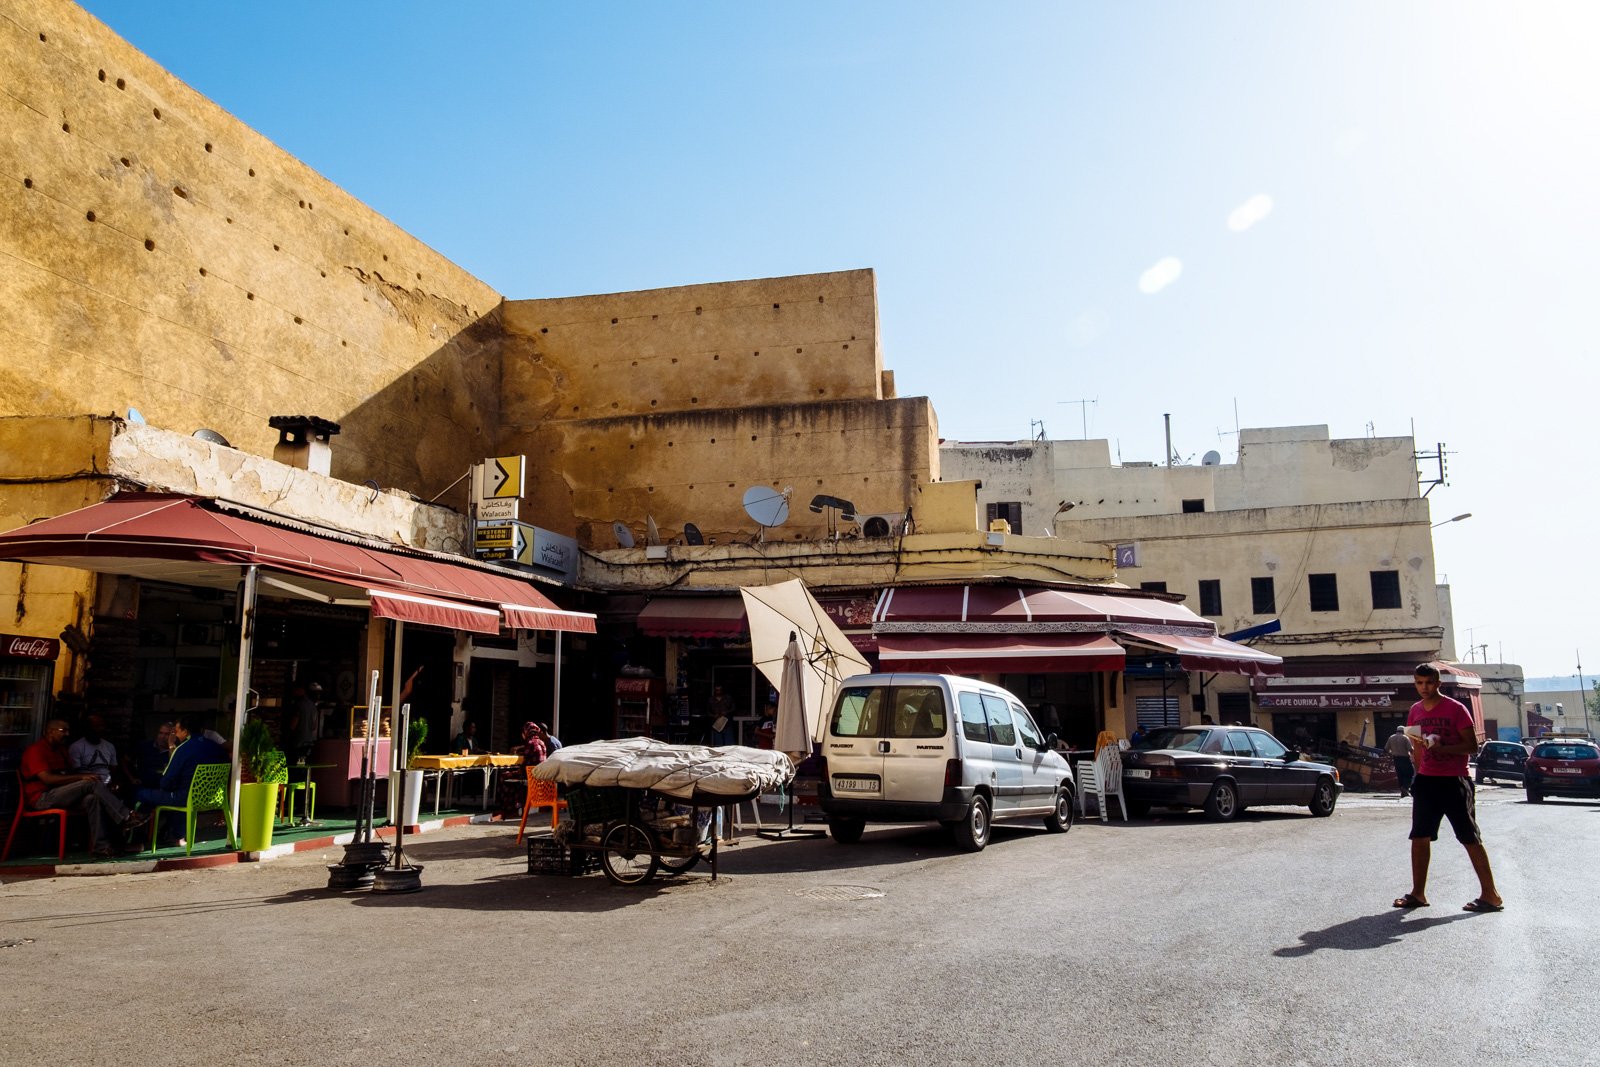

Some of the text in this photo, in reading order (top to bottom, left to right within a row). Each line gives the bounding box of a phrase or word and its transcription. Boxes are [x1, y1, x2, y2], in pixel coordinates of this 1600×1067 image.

[481, 501, 512, 509] وفاكاش
[481, 510, 512, 518] Wafacash
[482, 551, 506, 559] Change
[9, 637, 50, 656] Coca-Cola
[1275, 698, 1318, 706] CAFE OURIKA
[837, 780, 856, 789] 43199
[868, 781, 877, 790] 15
